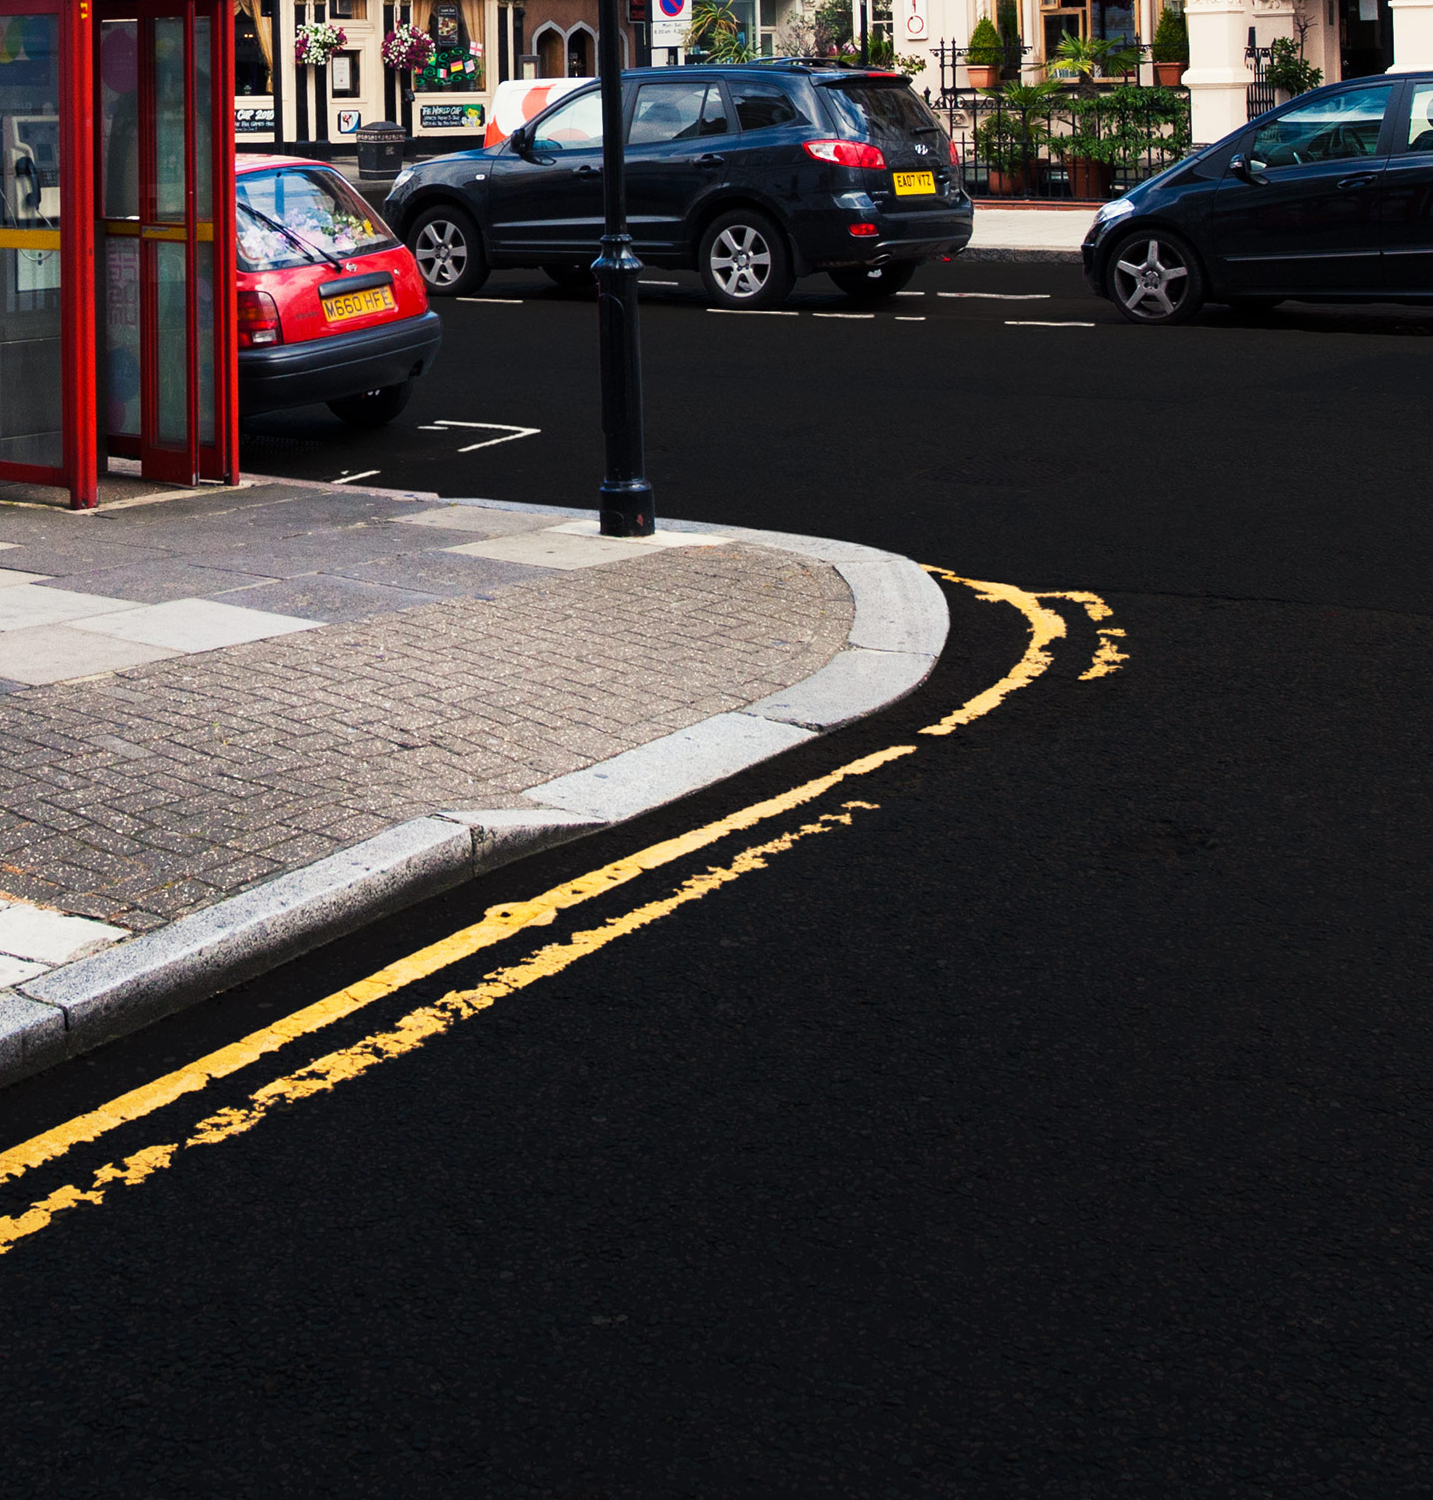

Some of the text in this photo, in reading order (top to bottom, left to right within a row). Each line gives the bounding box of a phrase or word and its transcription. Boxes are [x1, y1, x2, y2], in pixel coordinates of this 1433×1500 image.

[897, 174, 915, 187] EA07
[324, 289, 393, 319] M660 HFE
